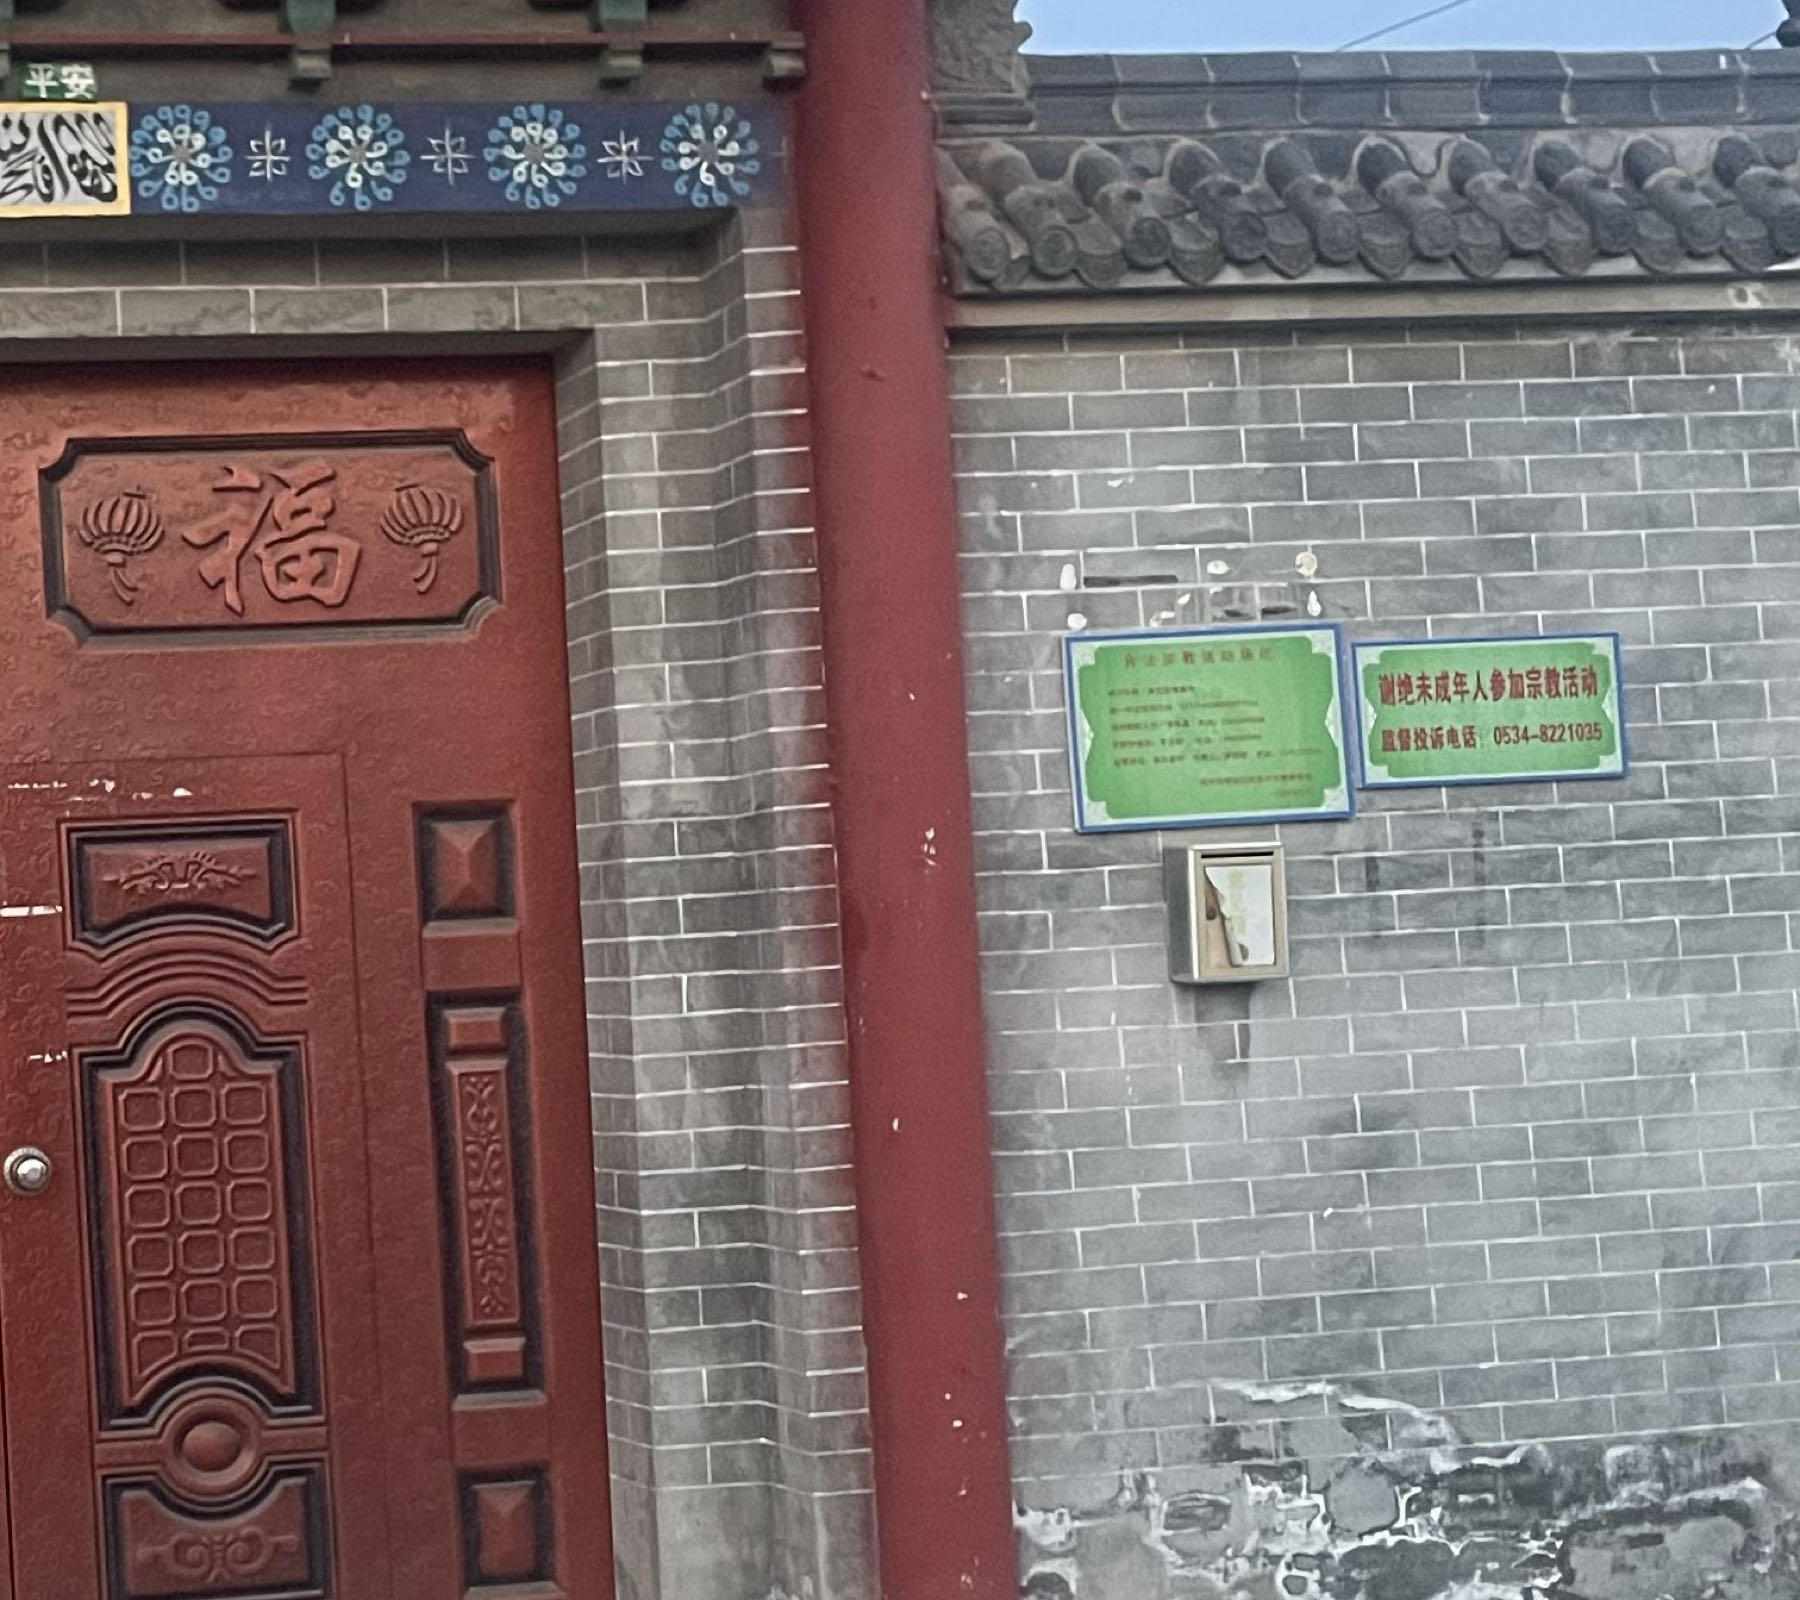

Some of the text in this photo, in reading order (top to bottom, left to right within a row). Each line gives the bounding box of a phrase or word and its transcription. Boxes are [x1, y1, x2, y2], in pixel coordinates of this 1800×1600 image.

[24, 62, 97, 100] 平安
[182, 464, 362, 615] 福
[1378, 664, 1599, 707] 谢绝未成年人参加宗教活动
